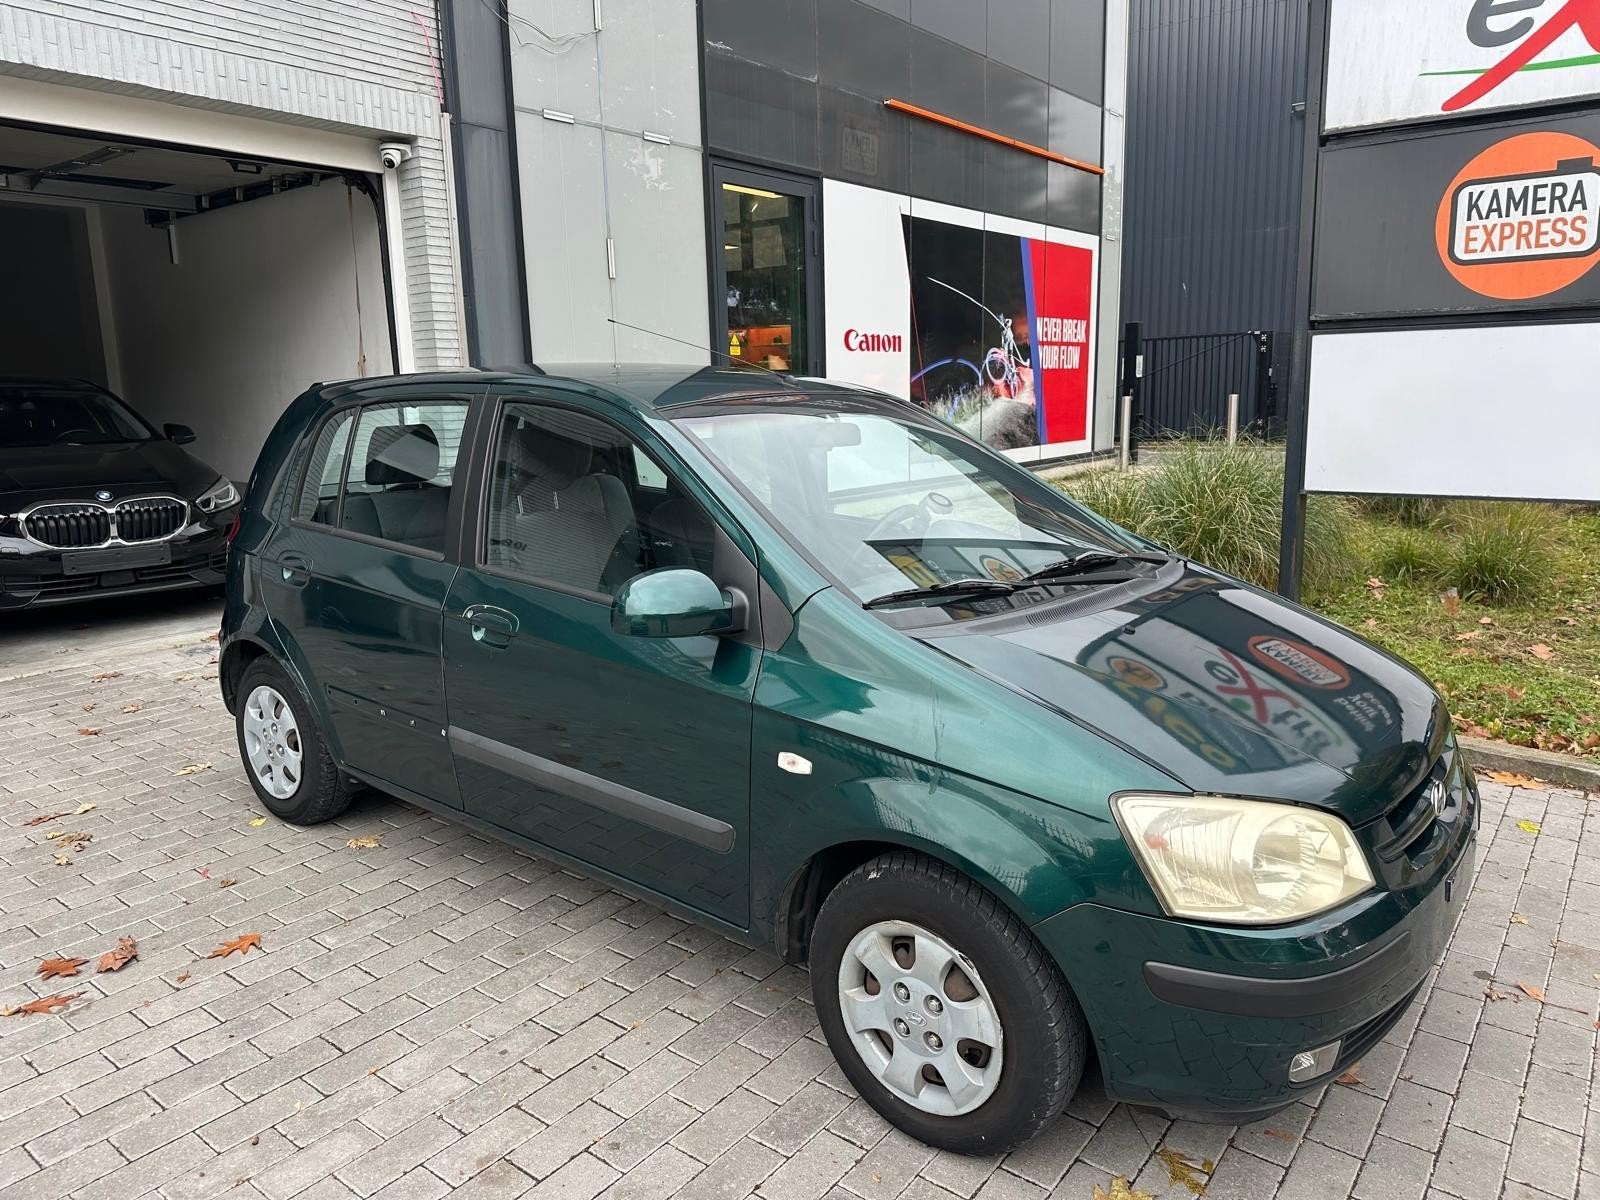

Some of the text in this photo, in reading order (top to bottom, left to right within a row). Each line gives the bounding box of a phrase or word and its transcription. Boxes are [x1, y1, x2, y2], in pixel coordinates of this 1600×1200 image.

[1466, 179, 1588, 222] KAMERA
[1463, 215, 1588, 254] EXPRESS
[844, 329, 902, 352] Canon
[1036, 317, 1087, 343] NEVER BREAK
[1038, 344, 1080, 369] YOUR FLOW
